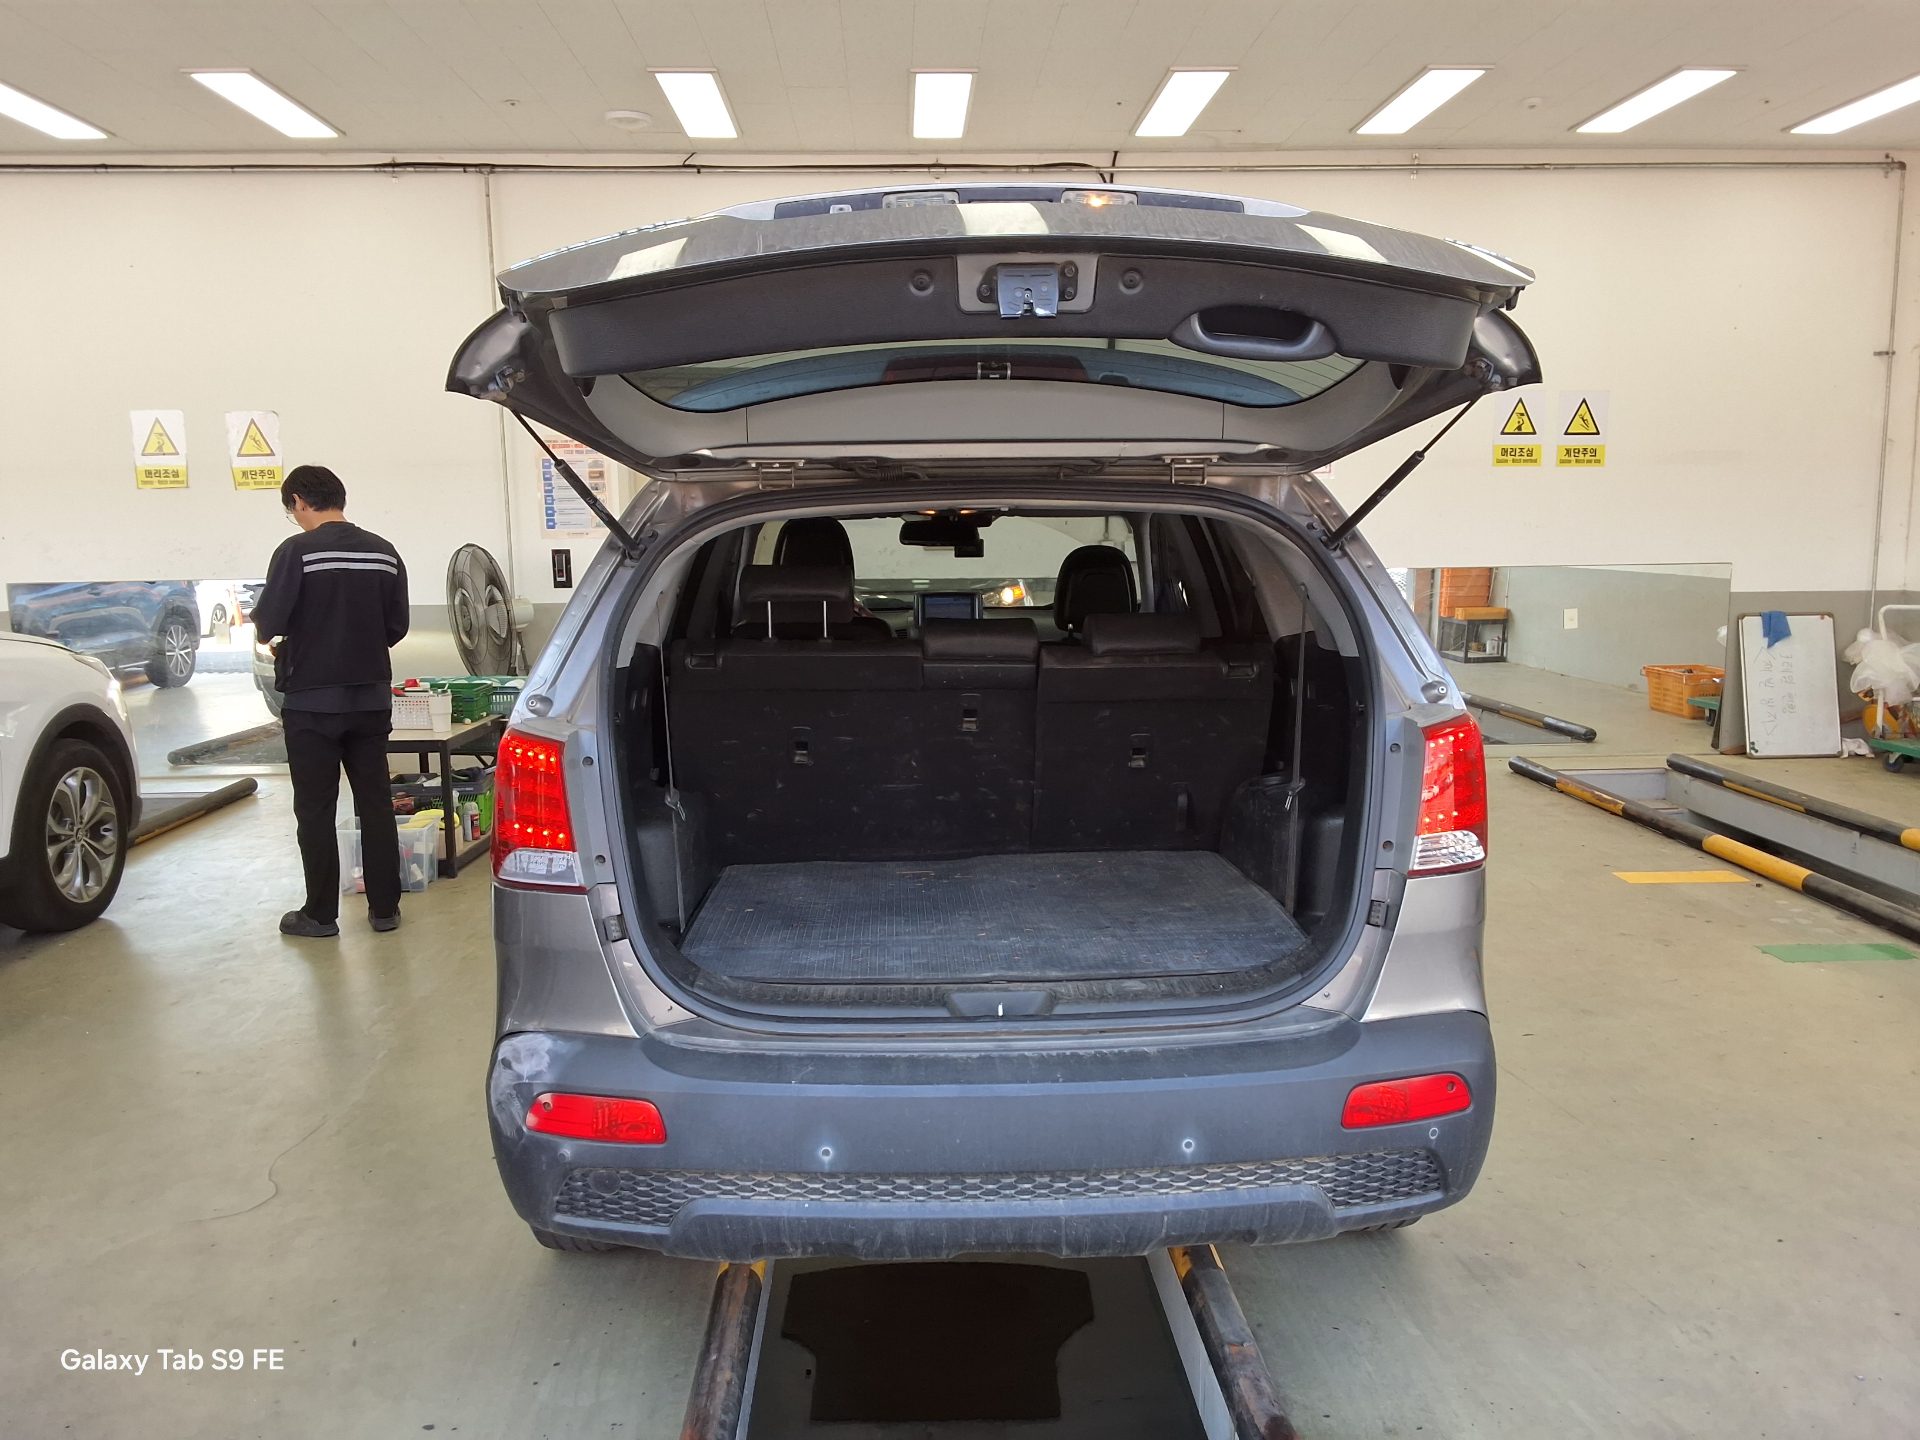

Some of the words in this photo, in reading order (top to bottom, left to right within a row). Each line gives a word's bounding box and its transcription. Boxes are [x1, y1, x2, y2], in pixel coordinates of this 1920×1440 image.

[1500, 447, 1534, 457] 머리조심
[1563, 447, 1597, 458] 계단주의
[241, 469, 276, 480] 계단주의
